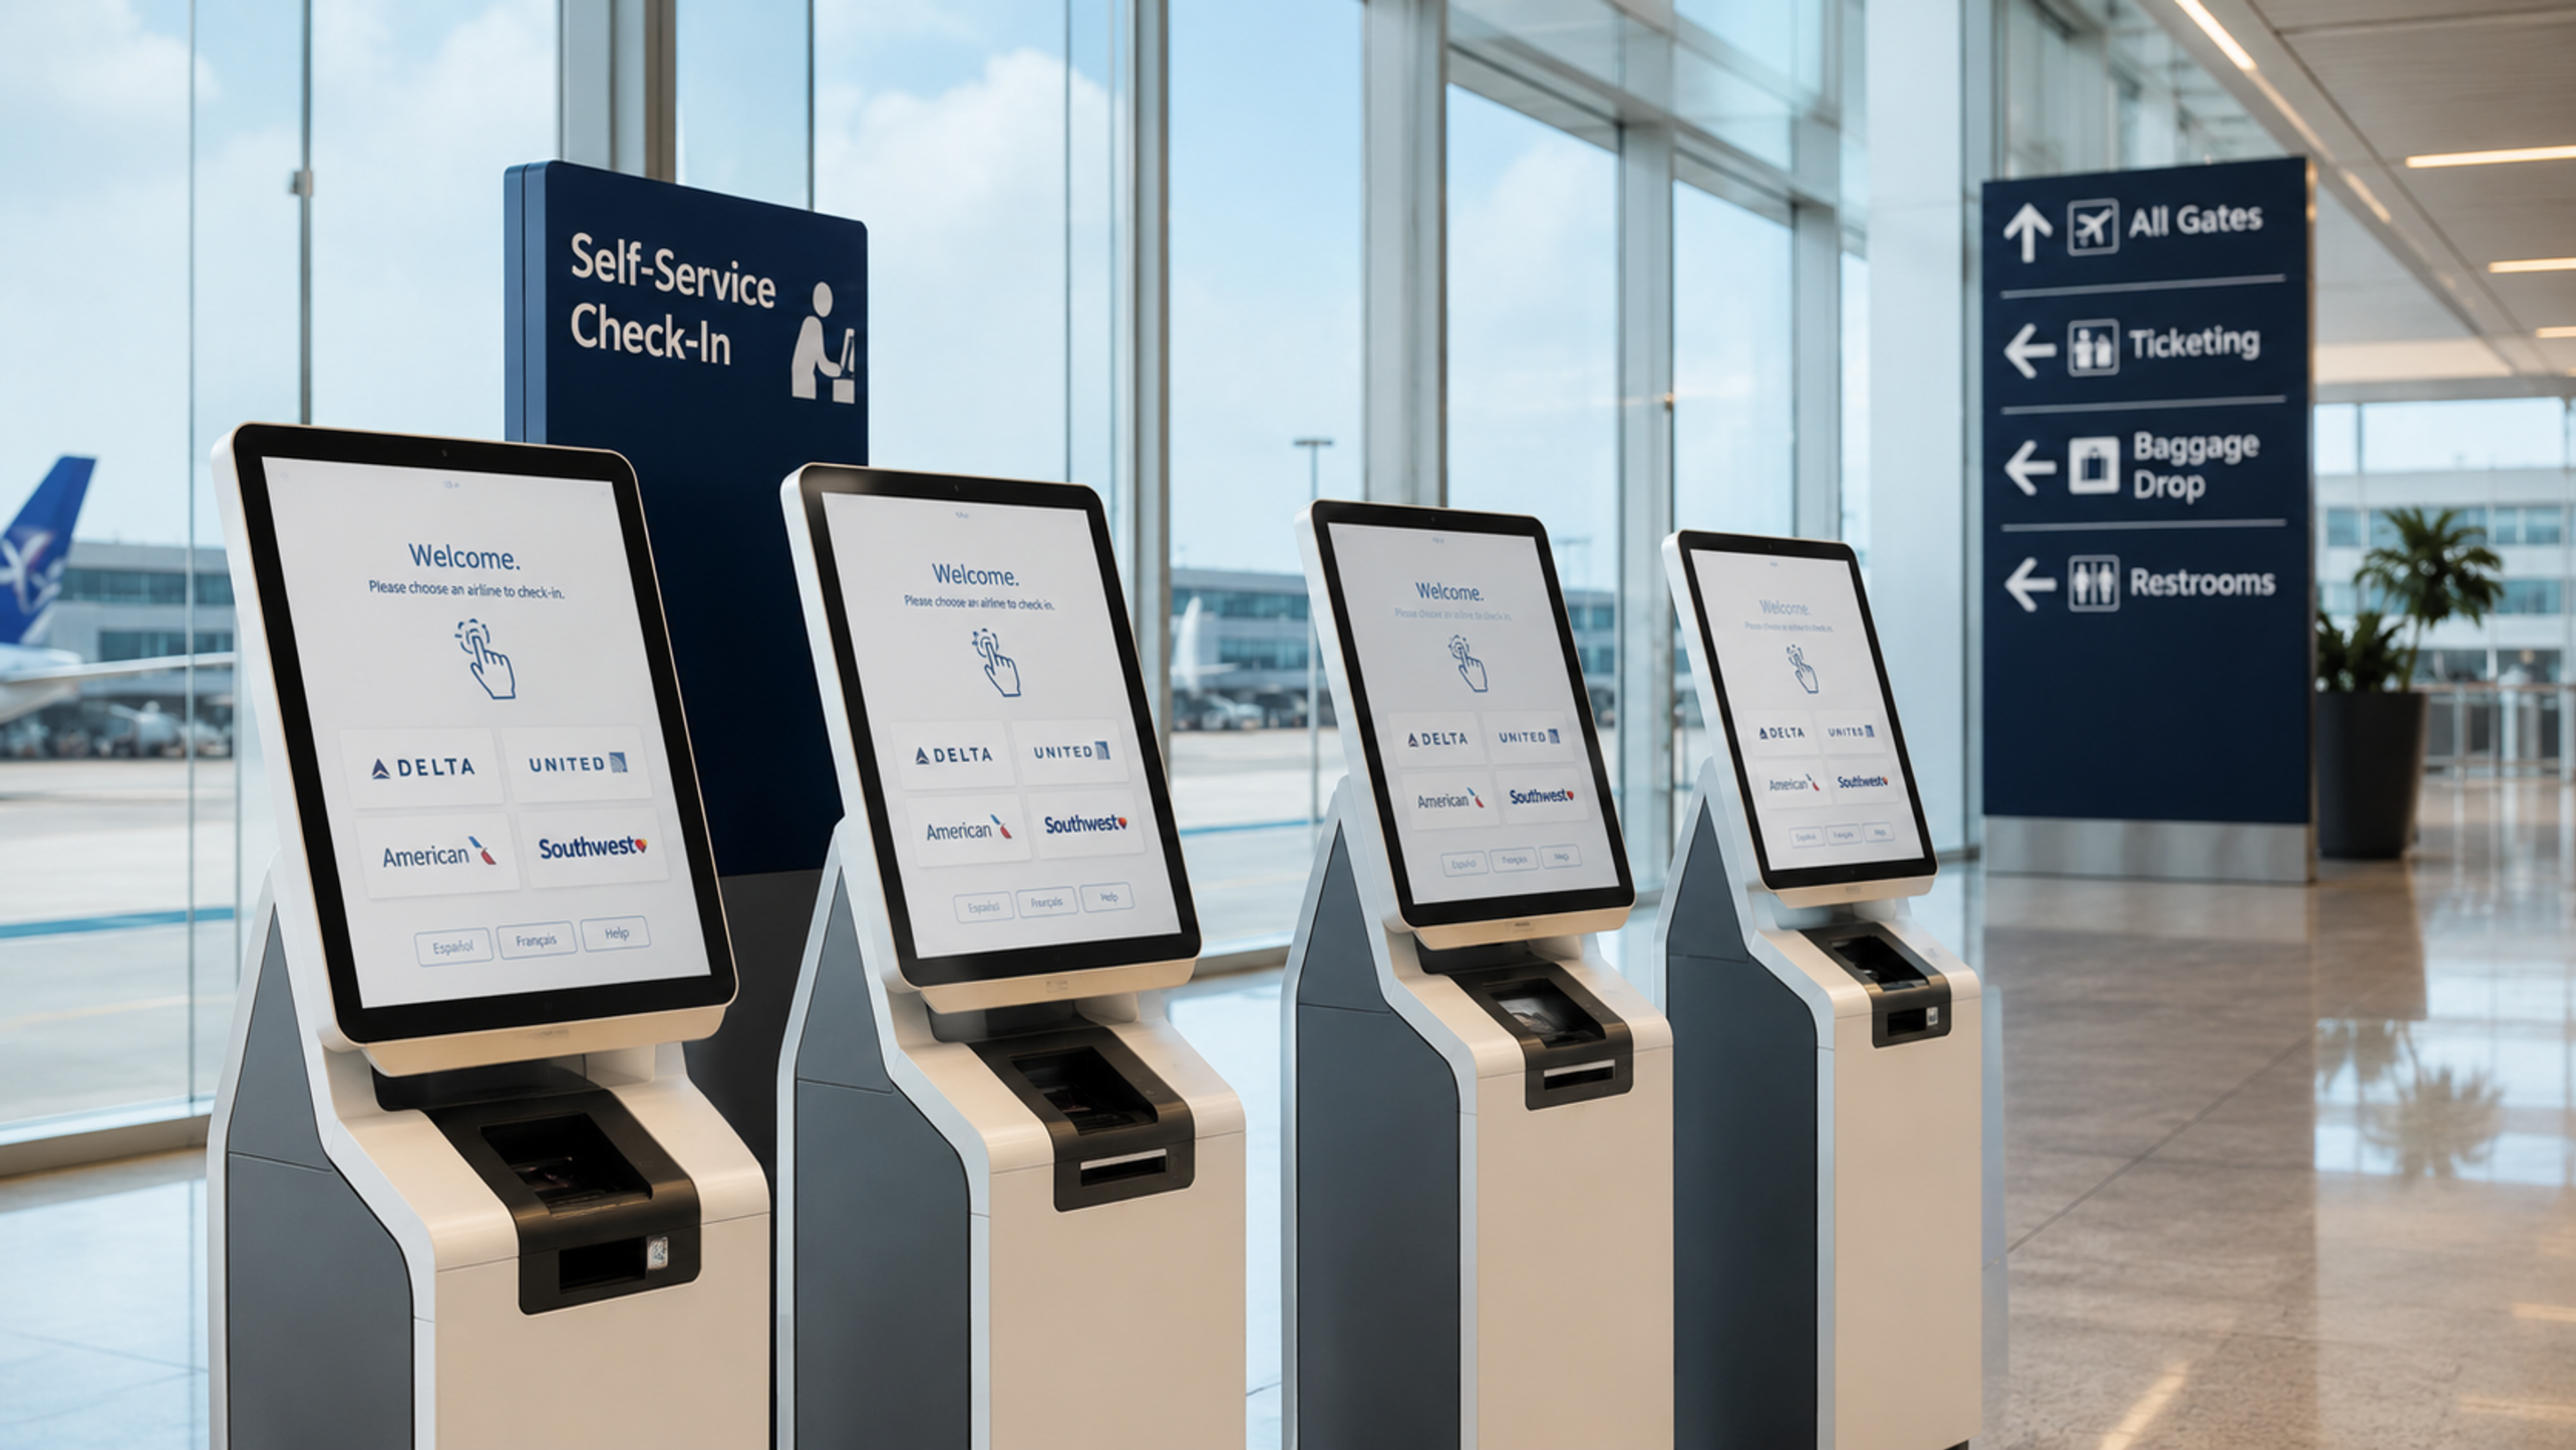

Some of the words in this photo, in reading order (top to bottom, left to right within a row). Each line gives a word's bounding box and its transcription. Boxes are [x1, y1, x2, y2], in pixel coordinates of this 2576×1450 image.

[2129, 205, 2169, 237] All
[2177, 205, 2263, 234] Gates
[572, 232, 775, 309] Self-Service
[572, 303, 731, 365] Check-In
[2129, 325, 2259, 360] Ticketing
[2135, 431, 2259, 466] Baggage
[2135, 470, 2205, 504] Drop
[409, 543, 520, 570] Welcome.
[932, 564, 1019, 586] Welcome.
[2131, 568, 2275, 596] Restrooms
[369, 580, 406, 594] Please
[409, 581, 449, 595] choose
[451, 586, 464, 595] an
[468, 584, 502, 597] airline
[504, 586, 515, 597] to
[518, 586, 565, 599] check-in.
[1415, 582, 1484, 601] Welcome.
[1421, 733, 1467, 745] DELTA
[1499, 732, 1546, 743] UNITED
[1769, 727, 1805, 739] DELTA
[934, 747, 992, 762] DELTA
[1034, 746, 1092, 759] UNITED
[398, 758, 475, 776] DELTA
[529, 757, 604, 772] UNITED
[1417, 794, 1469, 809] American
[1509, 788, 1566, 805] Southwest
[927, 821, 992, 841] American
[1044, 814, 1118, 834] Southwest
[384, 845, 469, 868] American
[539, 836, 633, 860] Southwest
[516, 936, 557, 948] Français
[605, 927, 629, 941] Help
